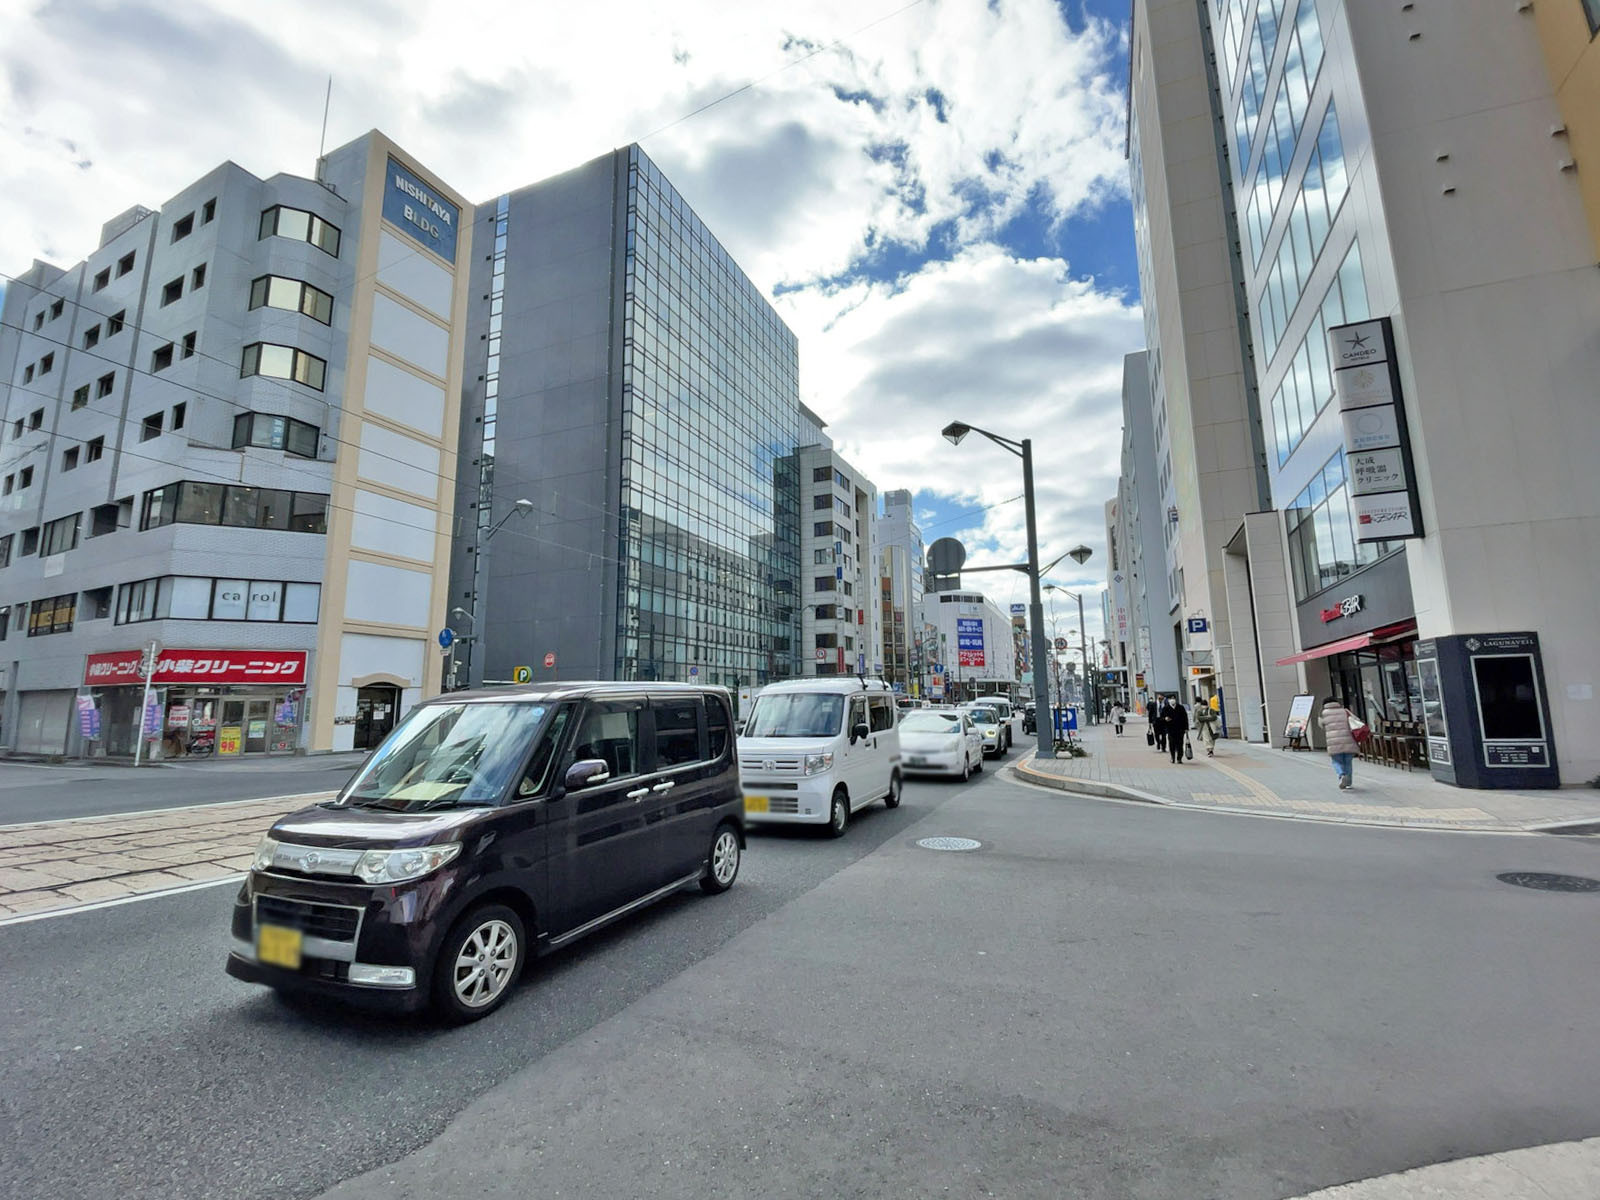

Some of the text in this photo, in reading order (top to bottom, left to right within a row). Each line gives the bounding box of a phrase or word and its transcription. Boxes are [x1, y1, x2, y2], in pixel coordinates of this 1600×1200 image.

[395, 175, 452, 226] NISHITAYA
[403, 204, 440, 240] BLDG
[1357, 473, 1399, 485] クリニック
[1192, 620, 1204, 632] P
[158, 659, 300, 675] 小柴クリーニング
[519, 669, 528, 682] P
